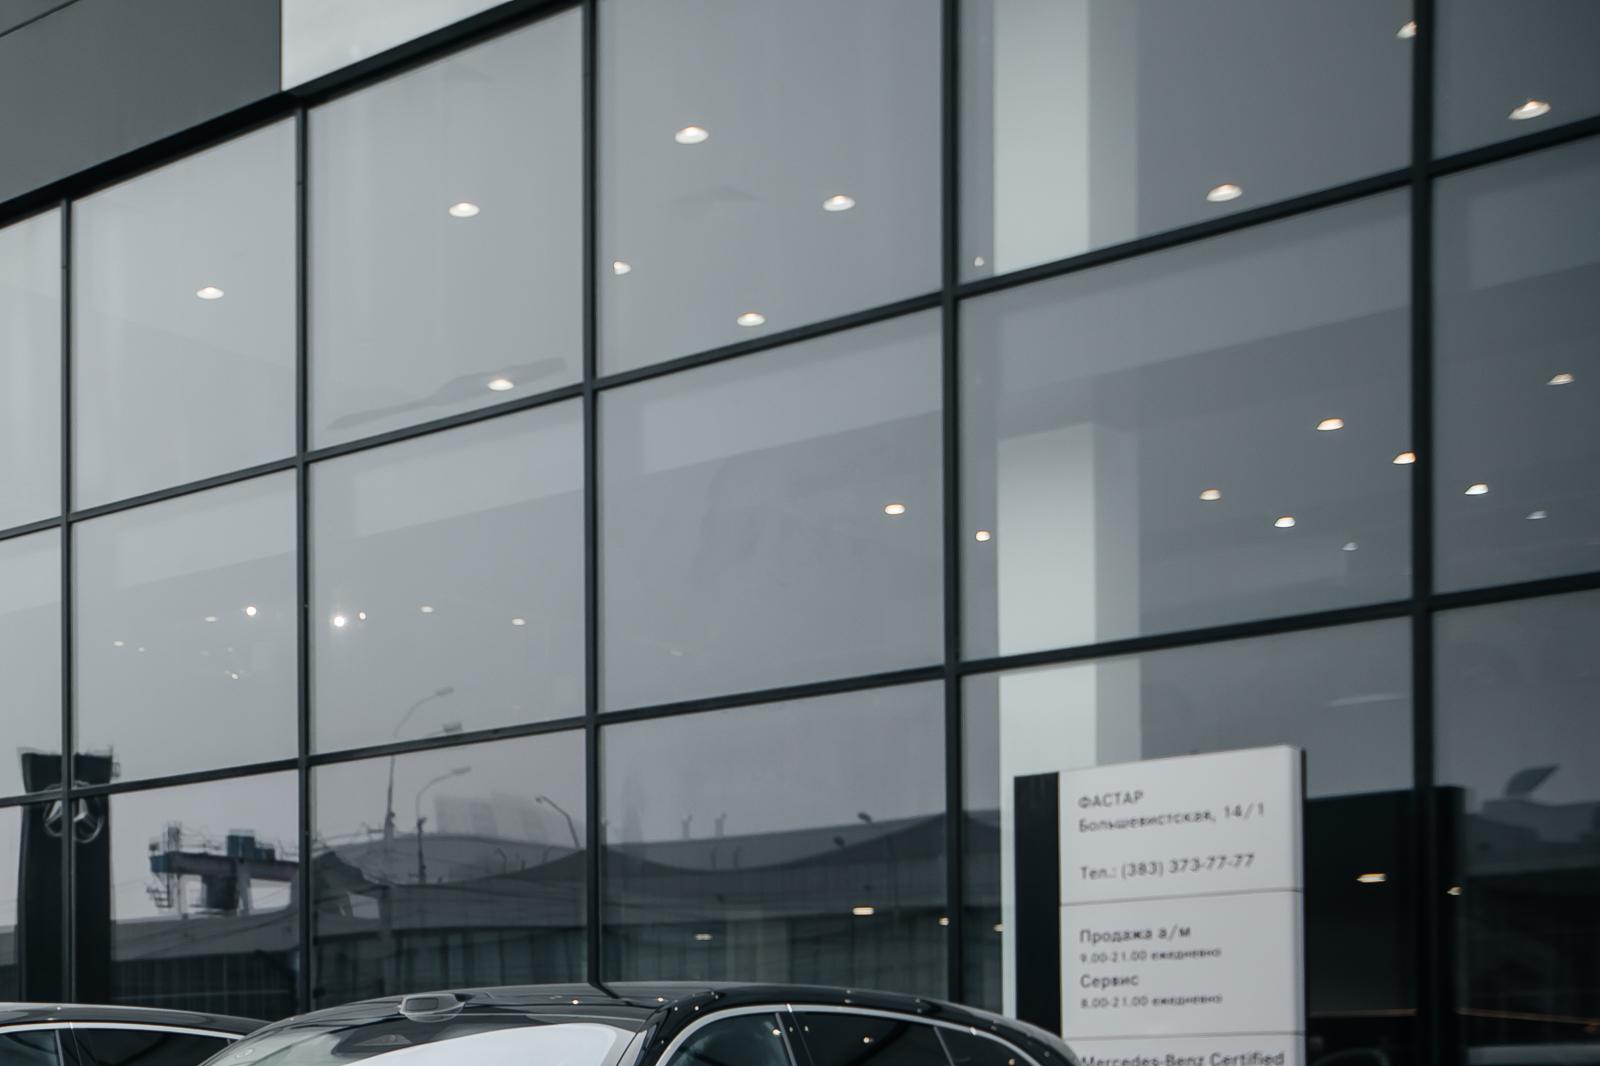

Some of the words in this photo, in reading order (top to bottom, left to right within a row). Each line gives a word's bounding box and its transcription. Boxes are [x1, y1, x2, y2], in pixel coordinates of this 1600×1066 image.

[1078, 790, 1144, 809] ФАСТАР
[1079, 808, 1216, 833] Большевистская,
[1224, 803, 1265, 819] 14/1
[1121, 860, 1164, 880] (383)
[1169, 853, 1256, 873] 373-77-77
[1080, 926, 1153, 947] Продажа
[1158, 924, 1191, 940] а/м
[1080, 973, 1139, 990] Сервис
